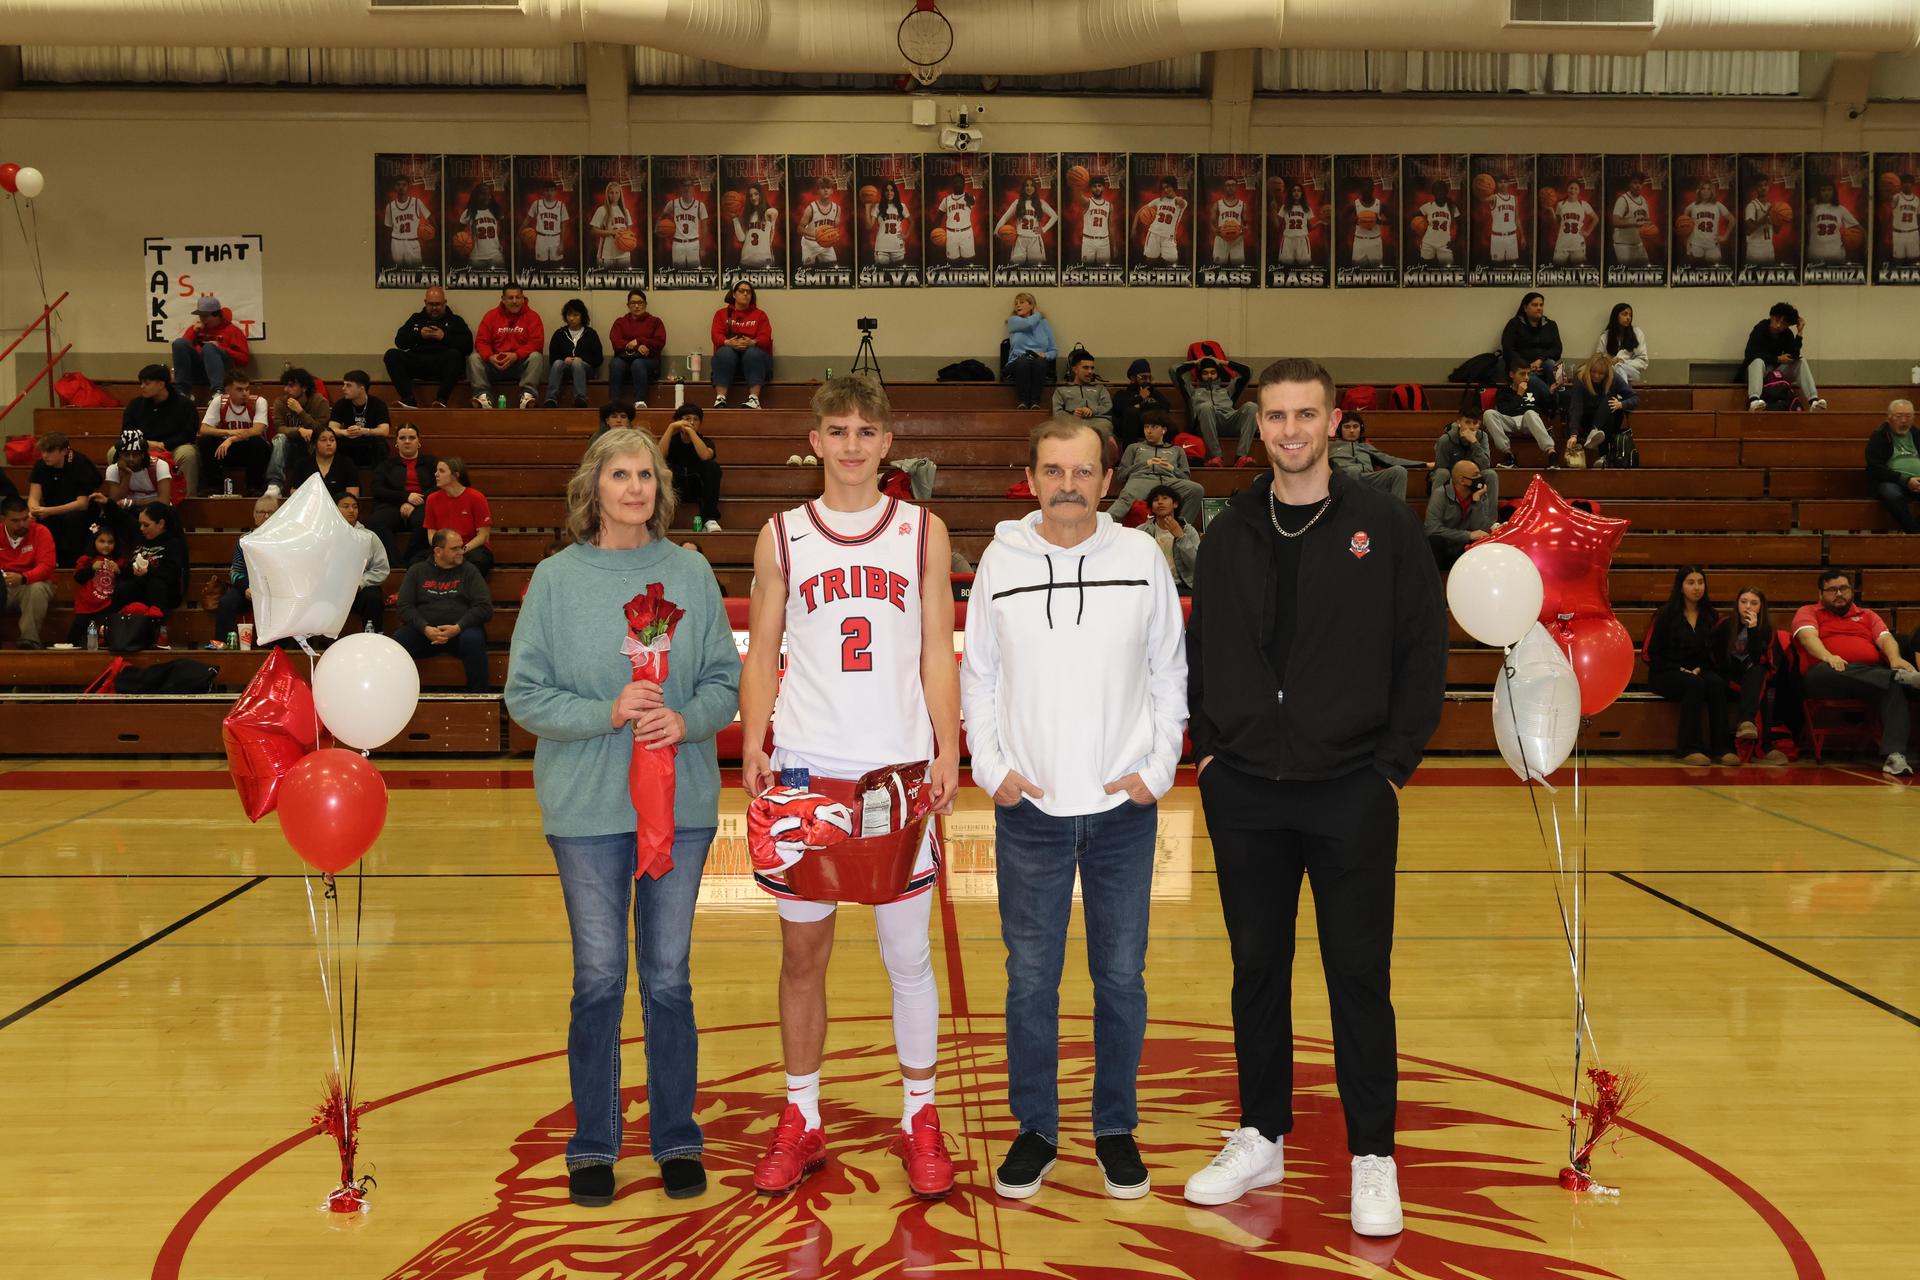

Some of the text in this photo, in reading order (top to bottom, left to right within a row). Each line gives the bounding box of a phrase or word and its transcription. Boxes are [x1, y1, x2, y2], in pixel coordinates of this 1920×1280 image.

[953, 212, 961, 223] 4
[751, 232, 759, 246] 3
[184, 243, 250, 265] THAT
[377, 273, 440, 288] AGUILAR
[446, 274, 509, 288] CARTER
[516, 274, 580, 288] WALTERS
[585, 273, 645, 288] NEWTON
[653, 273, 718, 288] BEARDSLEY
[795, 272, 850, 287] SMITH
[859, 271, 919, 287] SILVA
[925, 271, 990, 286] VAUGHN
[994, 271, 1057, 286] MARION
[1062, 271, 1124, 286] ESCHEIK
[1129, 271, 1192, 286] ESCHEIK
[1204, 271, 1253, 286] BASS
[1272, 272, 1325, 287] BASS
[1337, 272, 1398, 286] HEMPHILL
[1403, 271, 1466, 286] MOORE
[1469, 271, 1532, 285] DEATHERAGE
[1536, 271, 1600, 285] GONSALVES
[1608, 271, 1664, 285] ROMINE
[1672, 271, 1735, 285] MARCEAUX
[1804, 270, 1867, 283] MENDOZA
[148, 245, 172, 342] TAKE
[799, 564, 910, 615] TRIBE
[840, 616, 873, 673] 2
